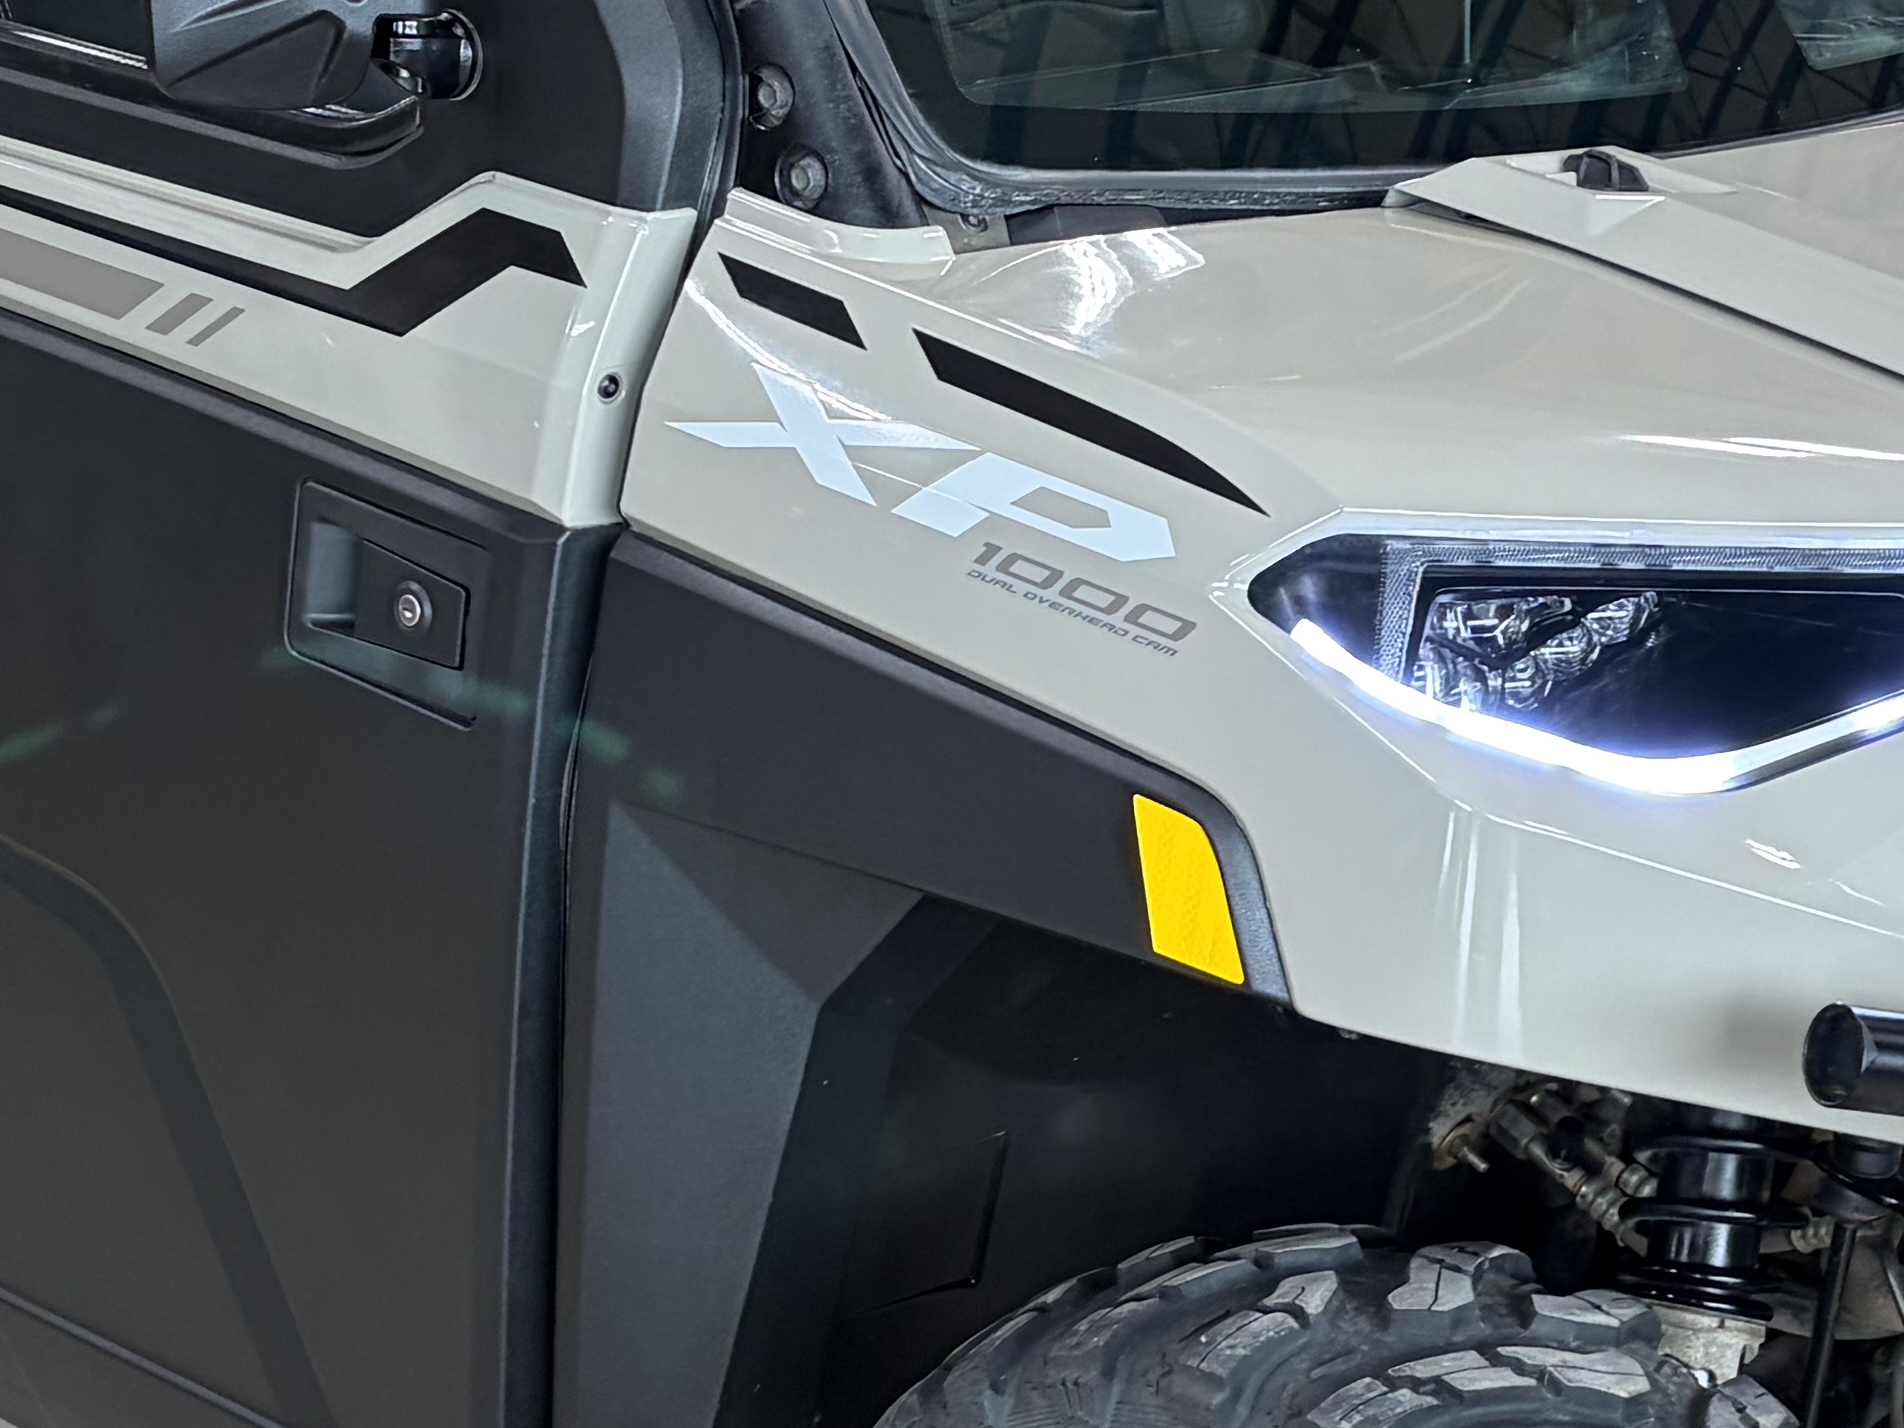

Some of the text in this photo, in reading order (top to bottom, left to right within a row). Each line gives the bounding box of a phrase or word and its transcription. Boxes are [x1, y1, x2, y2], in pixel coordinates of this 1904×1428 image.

[663, 362, 1176, 561] XP
[966, 568, 1179, 658] DUAL OVERHEAD CAM
[973, 541, 1197, 642] 1000
